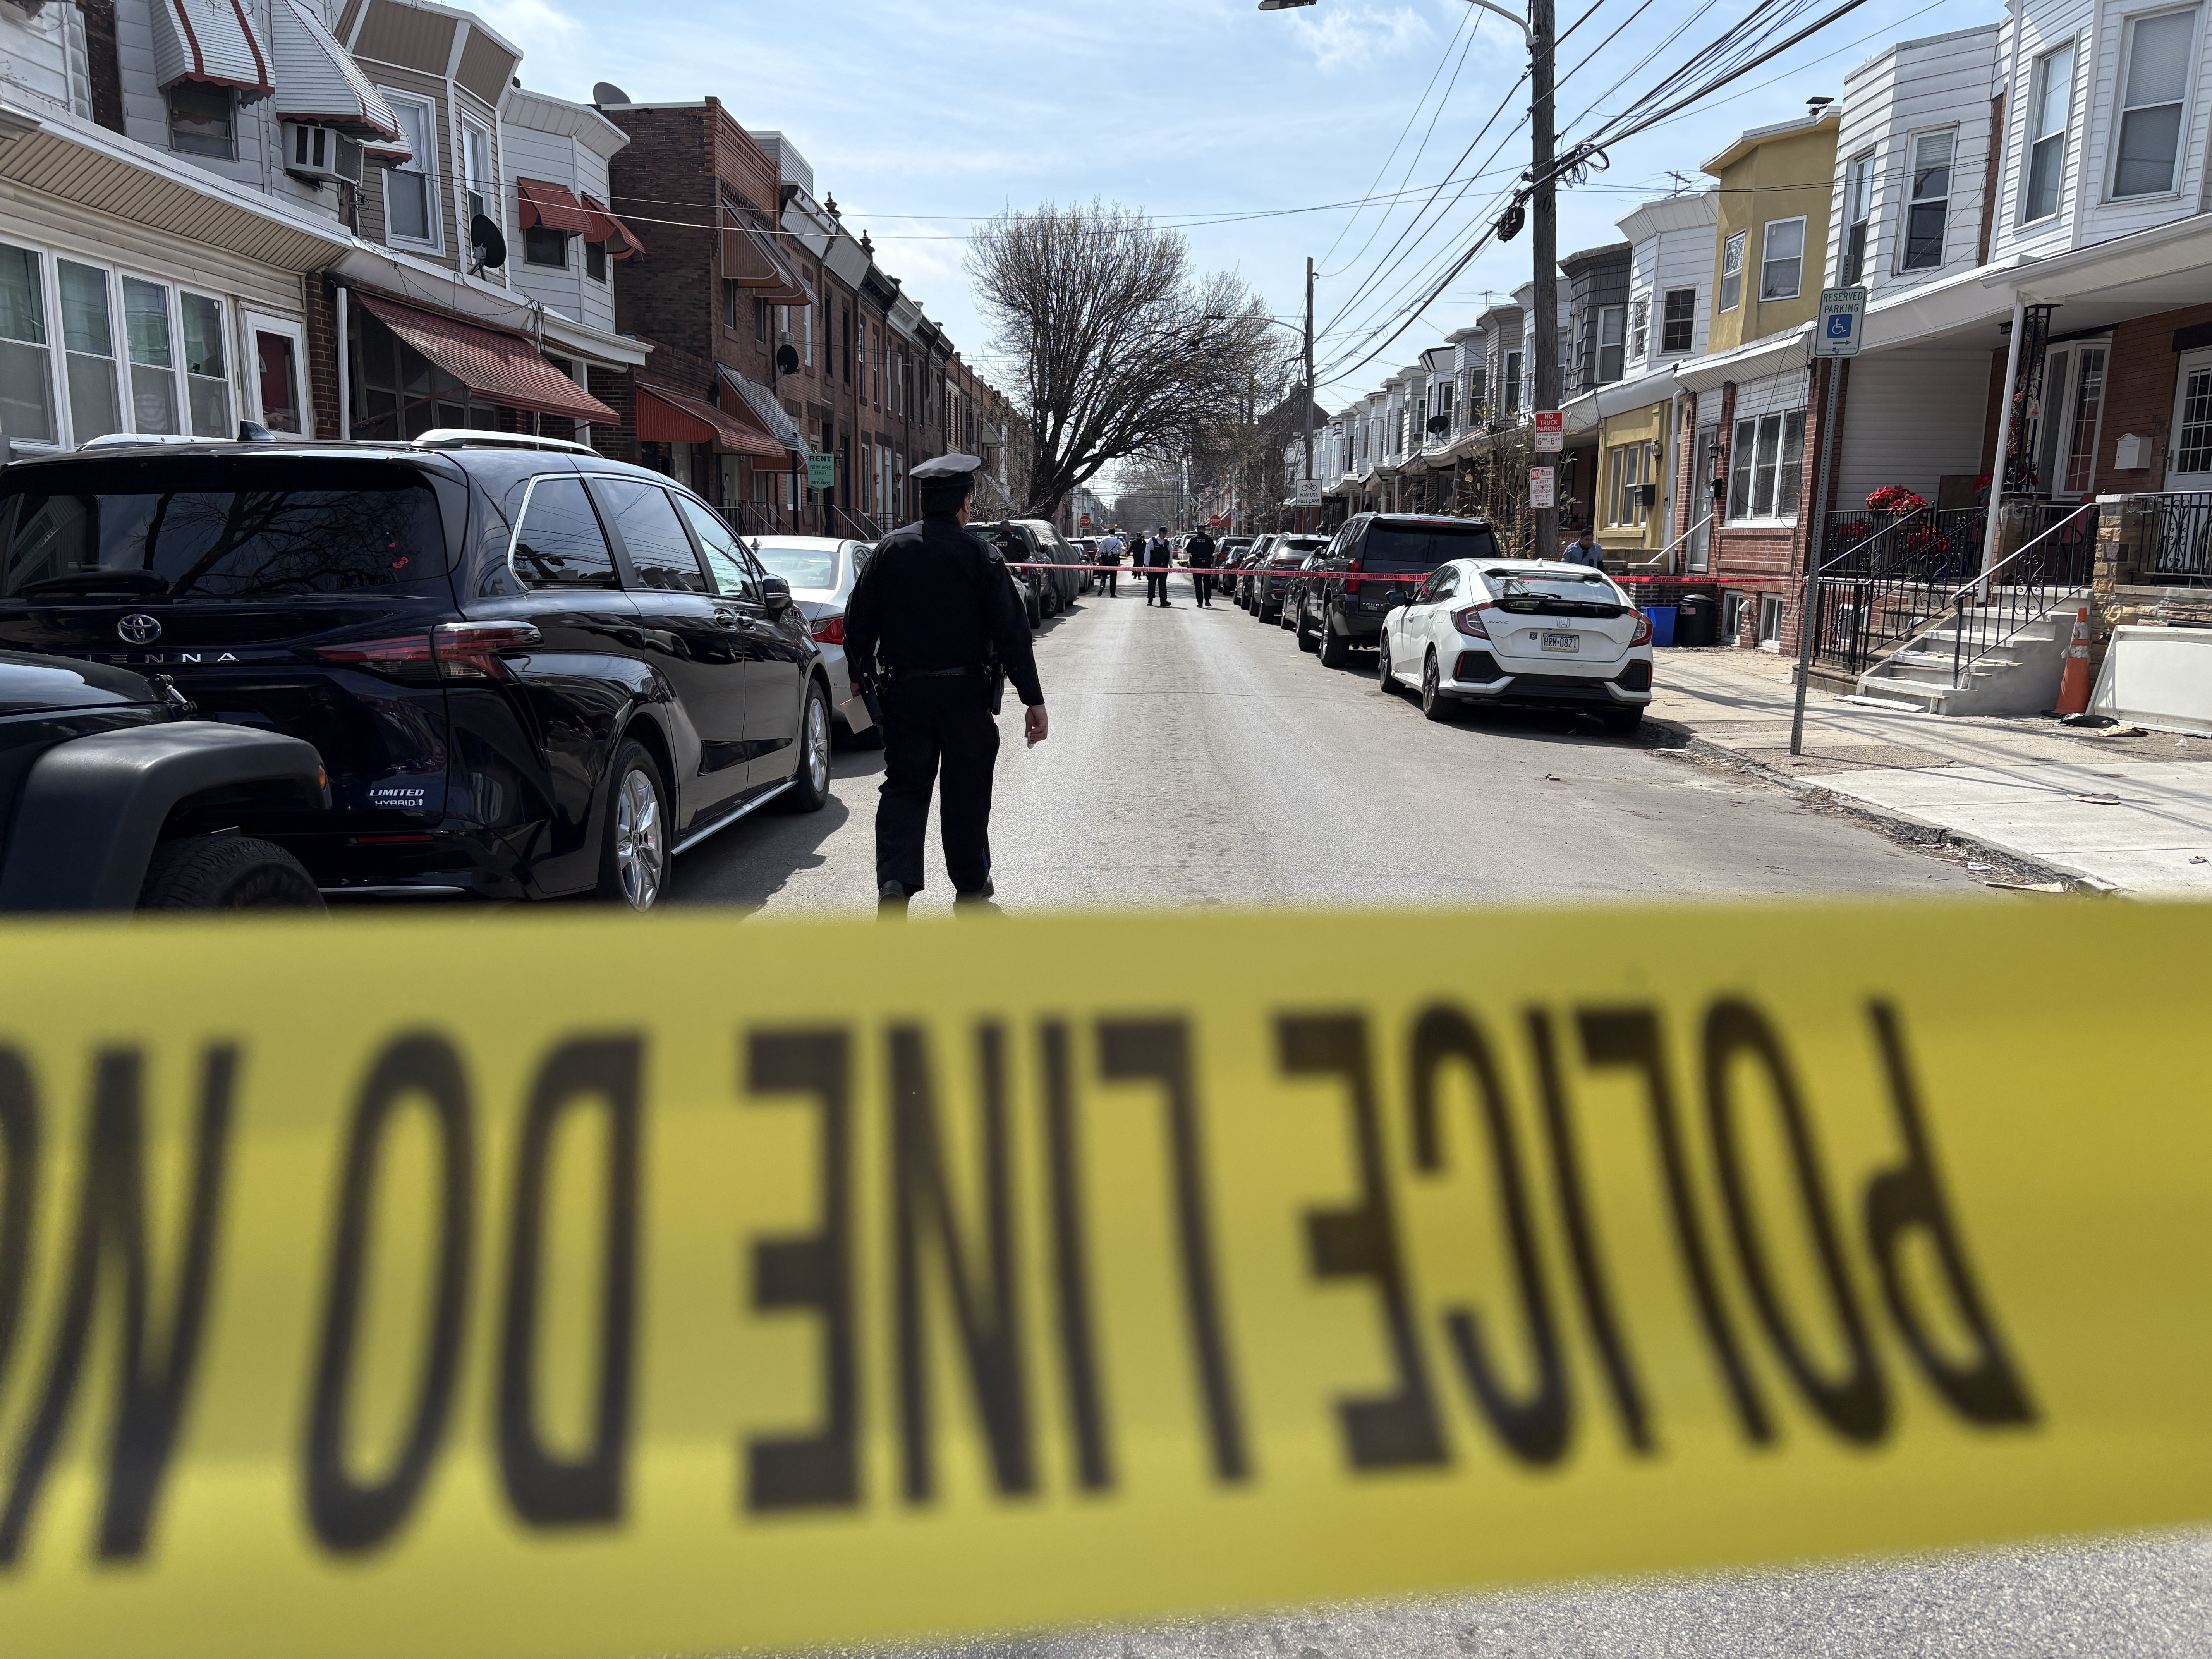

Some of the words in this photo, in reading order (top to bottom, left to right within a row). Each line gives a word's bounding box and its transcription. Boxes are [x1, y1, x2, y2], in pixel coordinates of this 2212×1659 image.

[1824, 292, 1863, 302] RESERVED
[1824, 304, 1859, 313] PARKING
[86, 653, 239, 663] IENNA
[304, 1022, 651, 1568] DO
[742, 1011, 1249, 1520] LINE
[1268, 991, 2045, 1479] POLICE
